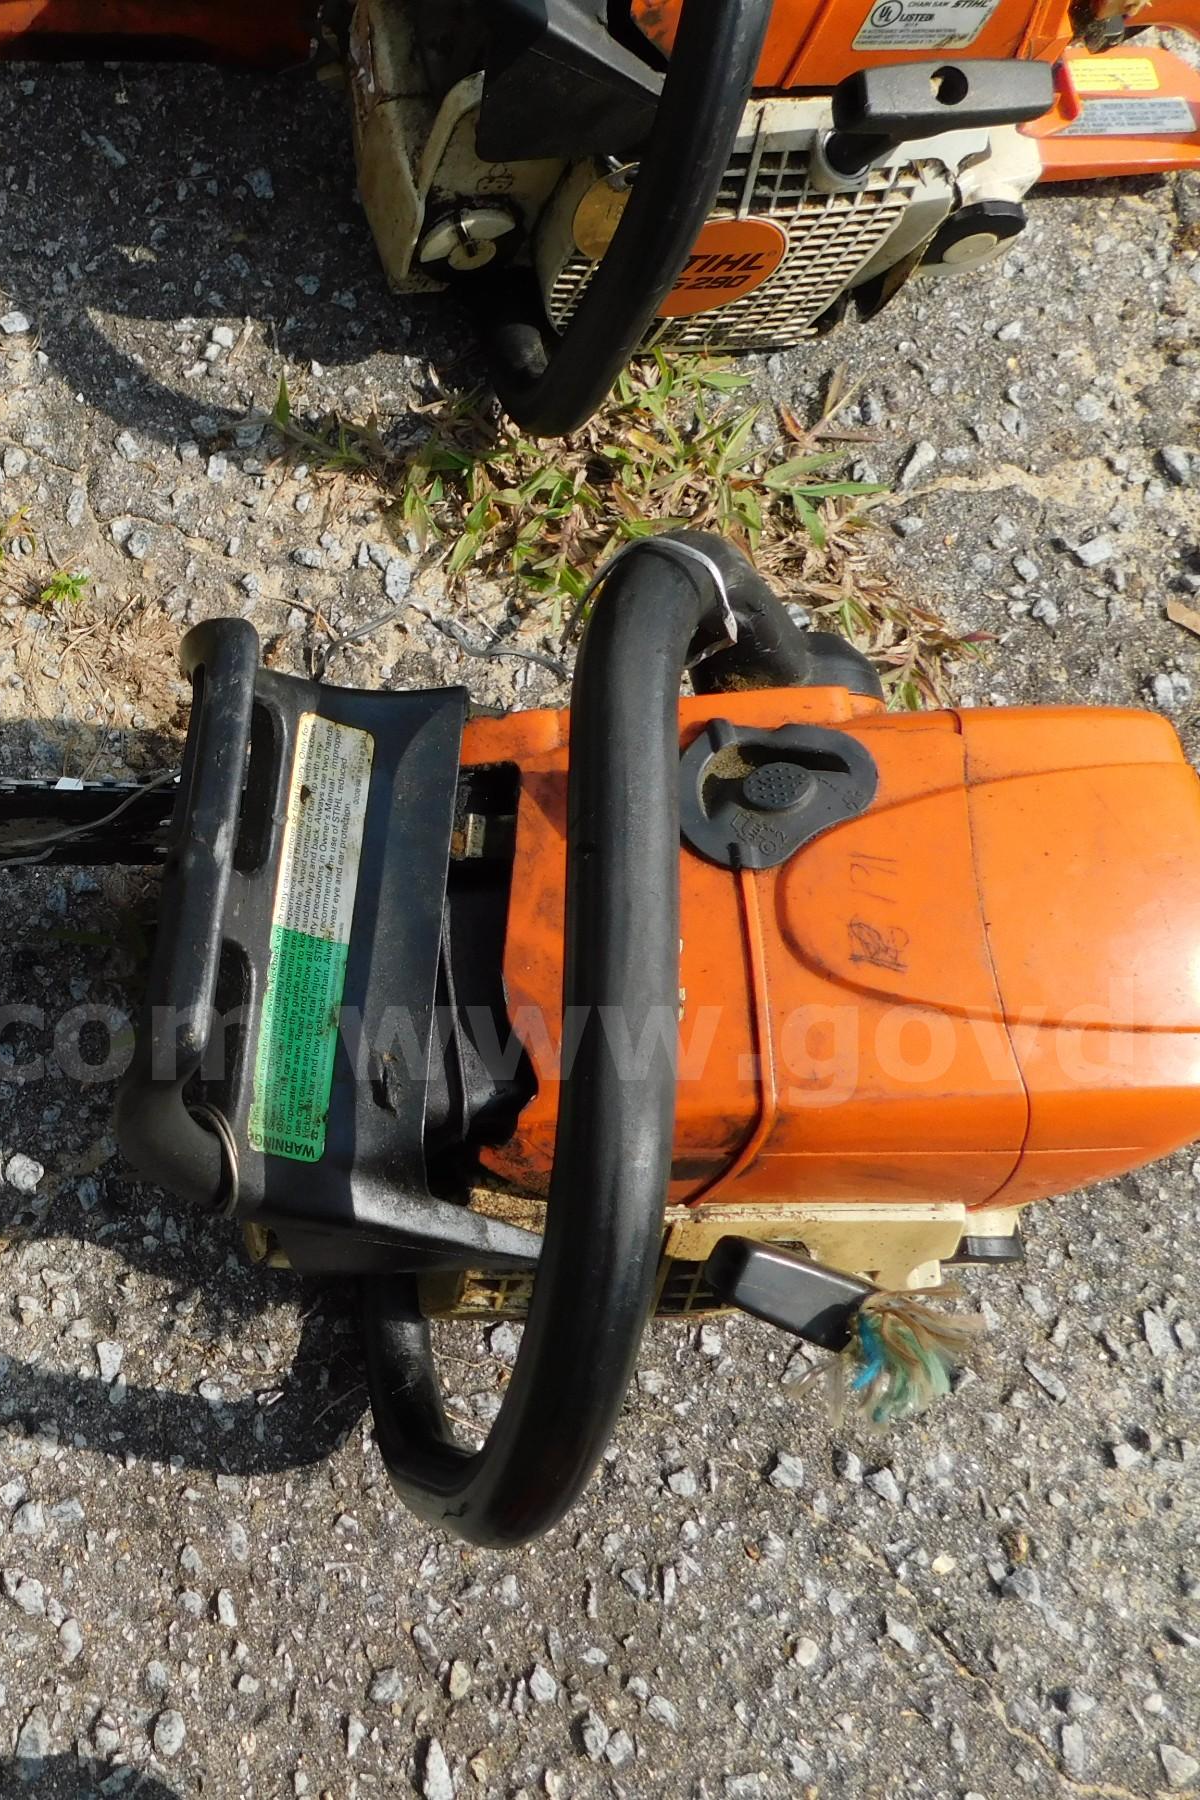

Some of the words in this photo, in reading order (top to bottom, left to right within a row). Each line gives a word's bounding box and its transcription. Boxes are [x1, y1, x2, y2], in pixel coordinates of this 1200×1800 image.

[879, 5, 895, 22] UL
[952, 0, 989, 8] STIHL
[899, 13, 936, 22] LISTED
[680, 252, 765, 273] TIHL
[684, 274, 752, 290] 290
[301, 722, 309, 737] for
[323, 723, 333, 752] hands
[298, 738, 309, 760] Only
[315, 741, 324, 760] any
[329, 727, 343, 770] improper
[303, 758, 312, 781] with
[311, 760, 320, 780] with
[320, 753, 329, 771] two
[319, 772, 327, 790] use
[335, 756, 347, 794] reduced
[309, 781, 319, 795] tip
[324, 777, 335, 813] Manual
[291, 791, 301, 812] fatal
[307, 796, 315, 811] bar
[314, 790, 326, 825] Always
[331, 794, 342, 823] STIHL
[291, 814, 298, 824] or
[305, 812, 313, 823] of
[338, 799, 353, 849] protection.
[294, 819, 306, 855] training
[301, 823, 312, 858] contact
[318, 813, 330, 852] Owner's
[330, 824, 339, 835] of
[285, 825, 296, 860] serious
[329, 835, 337, 853] use
[291, 855, 300, 875] and
[308, 851, 317, 869] and
[317, 853, 325, 863] in
[337, 849, 345, 866] ear
[283, 860, 292, 889] cause
[297, 859, 307, 887] Avoid
[307, 870, 316, 884] up
[333, 866, 343, 885] and
[280, 889, 290, 911] may
[284, 876, 298, 928] experience
[310, 864, 326, 919] precautions
[318, 869, 333, 932] recommends
[333, 886, 342, 904] eye
[292, 888, 304, 930] available.
[300, 885, 314, 929] suddenly
[329, 904, 338, 929] wear
[274, 912, 285, 942] which
[281, 928, 290, 946] and
[306, 919, 319, 950] safety
[290, 934, 298, 951] are
[298, 930, 307, 948] kick
[313, 934, 324, 963] STIHL
[323, 929, 336, 966] Always
[269, 943, 281, 984] kickback
[277, 949, 287, 978] needs
[296, 949, 304, 960] to
[304, 950, 313, 962] all
[283, 951, 297, 994] potential
[294, 962, 303, 978] bar
[300, 964, 311, 994] follow
[310, 964, 322, 995] injury.
[319, 966, 330, 995] chain.
[273, 979, 285, 1014] cutting
[290, 979, 302, 1008] guide
[298, 995, 307, 1014] and
[278, 995, 290, 1036] kickback
[288, 1008, 297, 1025] the
[307, 995, 317, 1017] fatal
[314, 996, 326, 1037] kickback
[264, 1020, 271, 1030] of
[294, 1016, 305, 1041] Read
[307, 1018, 314, 1030] or
[259, 1030, 272, 1071] capable
[286, 1027, 295, 1056] cause
[301, 1031, 312, 1066] serious
[311, 1038, 321, 1056] low
[273, 1038, 284, 1077] reduced
[283, 1057, 291, 1075] can
[309, 1058, 318, 1077] and
[290, 1066, 299, 1083] the
[299, 1068, 308, 1097] cause
[270, 1079, 279, 1098] with
[279, 1077, 289, 1096] This
[307, 1078, 316, 1096] bar
[285, 1084, 298, 1123] operate
[302, 1097, 314, 1138] kickbck
[284, 1124, 292, 1135] to
